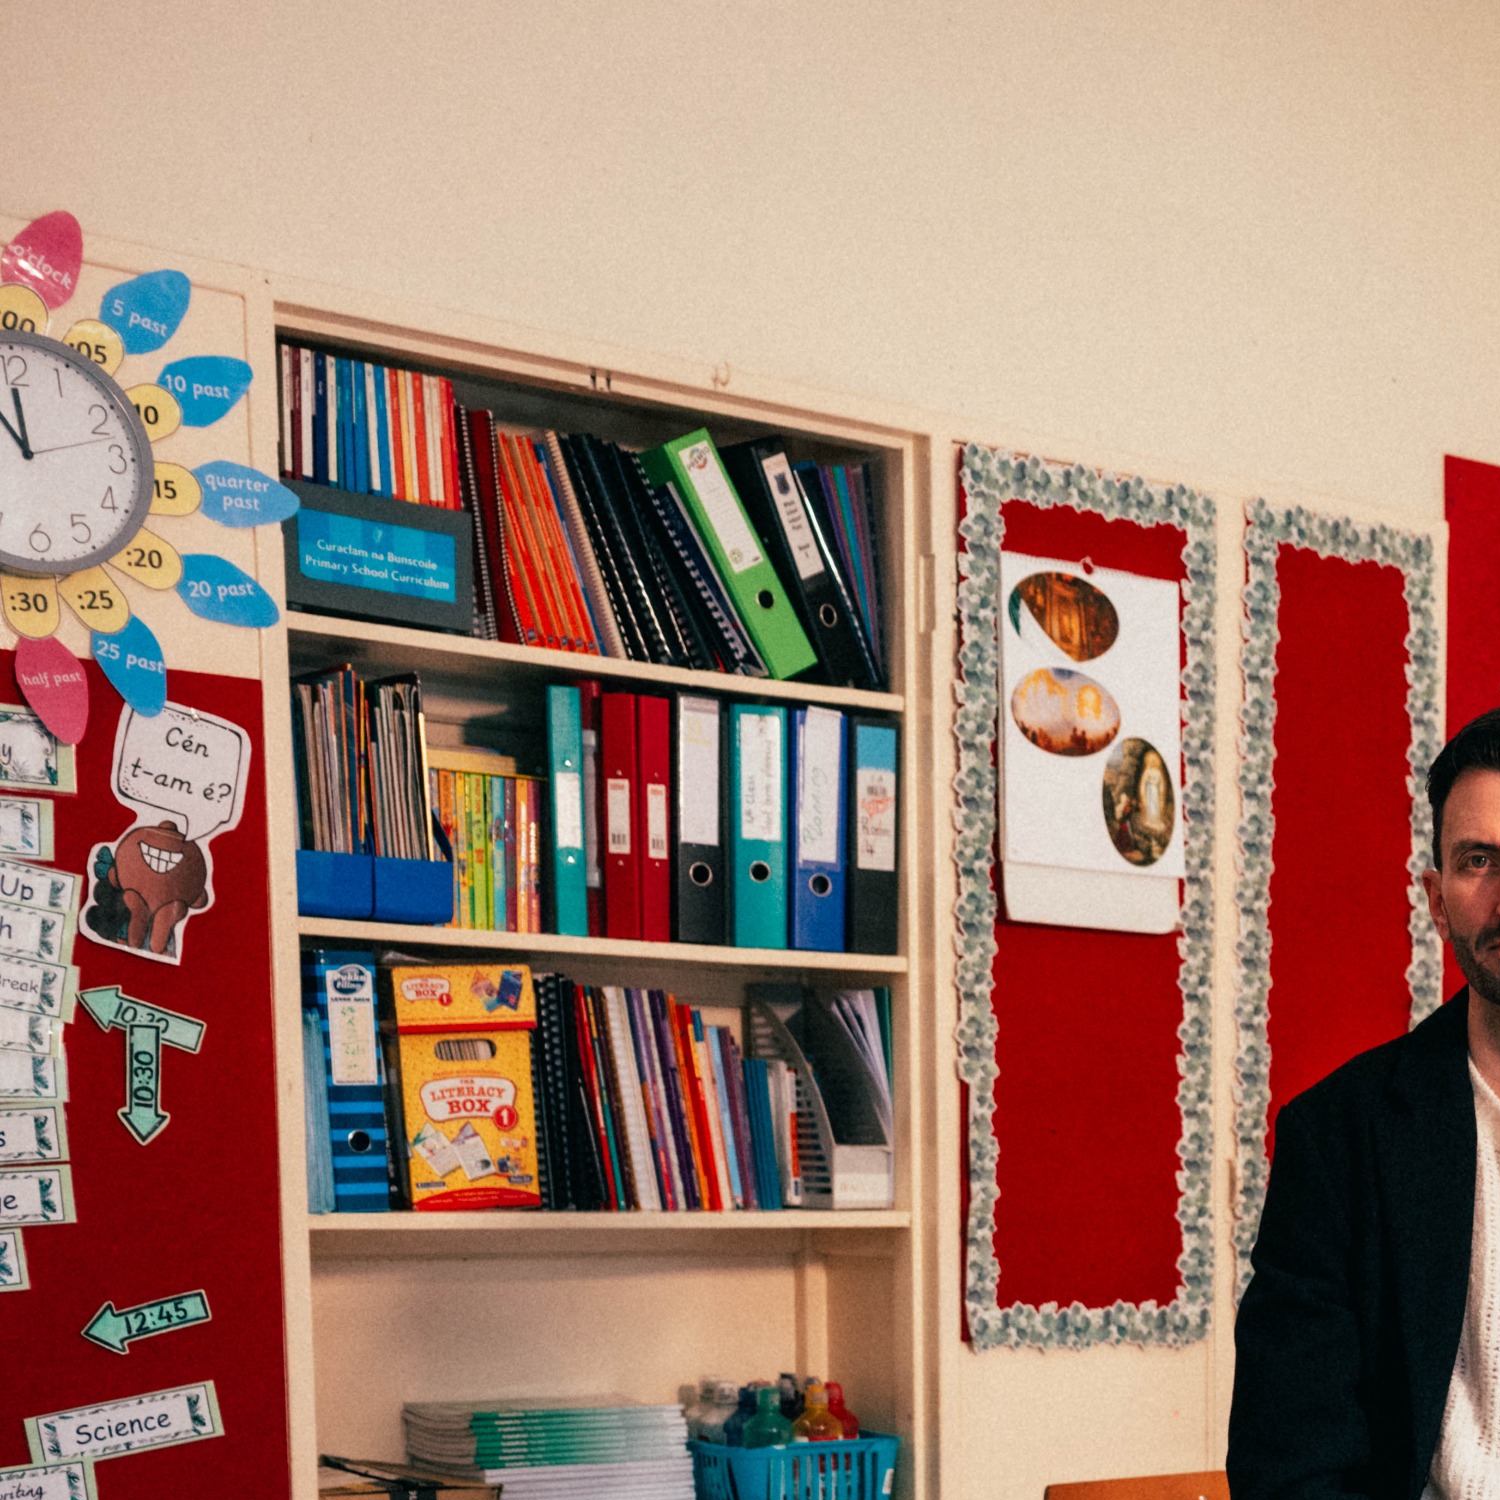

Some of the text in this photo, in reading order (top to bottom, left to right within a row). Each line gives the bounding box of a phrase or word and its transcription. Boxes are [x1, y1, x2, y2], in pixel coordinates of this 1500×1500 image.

[9, 244, 72, 290] o'clock
[111, 299, 168, 337] 5 past
[0, 354, 30, 387] 12
[53, 368, 63, 398] 1
[165, 374, 230, 400] 10 past
[88, 404, 110, 436] 2
[108, 444, 127, 475] 3
[204, 473, 270, 493] quarter
[100, 486, 119, 514] 4
[222, 493, 261, 511] past
[28, 522, 52, 553] 6
[70, 513, 92, 543] 5
[126, 549, 163, 570] :20
[317, 538, 437, 571] Curaclam na Bunscoile
[305, 553, 450, 591] Primary School Curriculum
[9, 592, 48, 613] :30
[77, 590, 114, 610] :25
[187, 581, 254, 602] 20 past
[97, 639, 166, 674] 25 past
[22, 670, 83, 688] half past
[165, 726, 210, 758] Cén
[131, 757, 232, 804] t-am é?
[0, 875, 34, 901] Up
[405, 982, 446, 992] LITERACY
[415, 988, 438, 999] BOX
[133, 1050, 155, 1108] 10:30
[430, 1086, 506, 1103] LITERACY
[447, 1099, 492, 1116] BOX
[500, 1108, 510, 1126] 1
[124, 1301, 188, 1335] 12:45
[75, 1412, 172, 1446] Science
